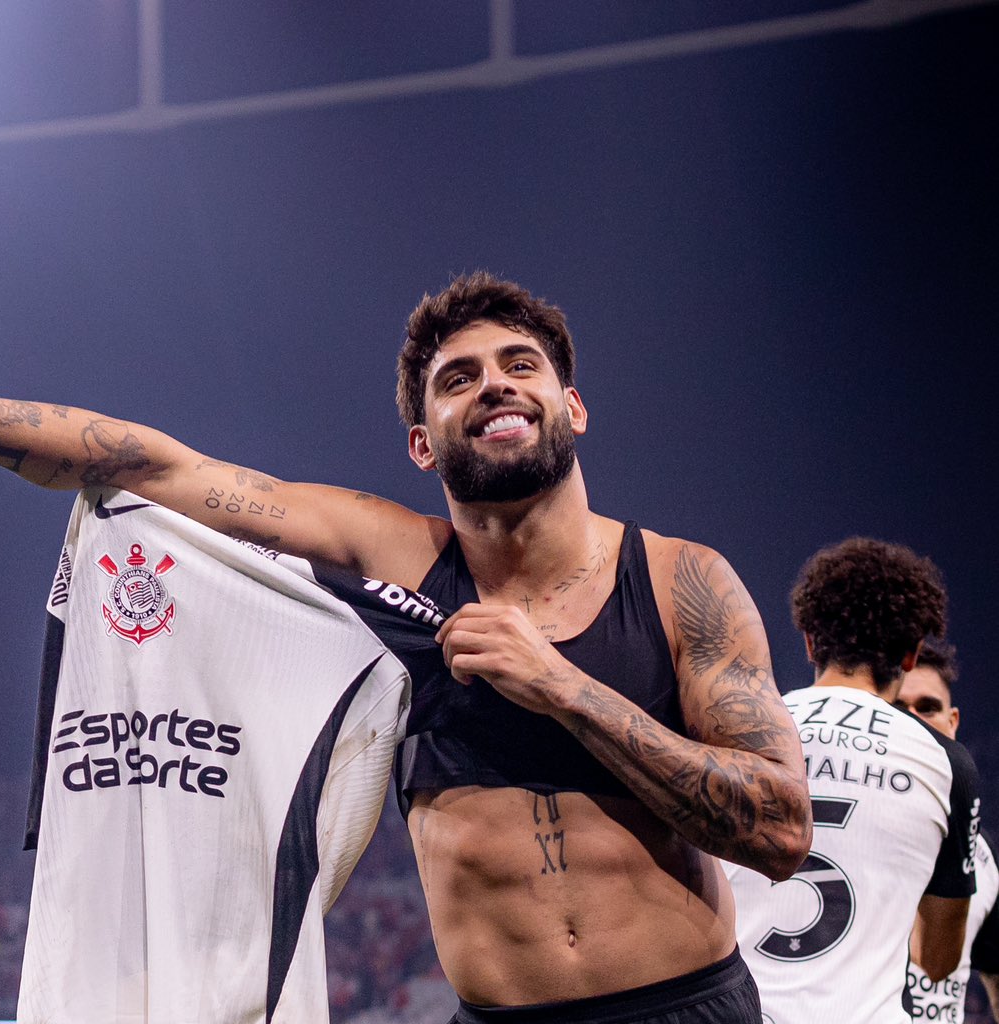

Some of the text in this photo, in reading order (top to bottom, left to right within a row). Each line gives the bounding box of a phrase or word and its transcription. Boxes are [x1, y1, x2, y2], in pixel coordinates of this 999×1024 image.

[52, 707, 242, 756] Esportes
[799, 726, 888, 756] GUROS
[62, 747, 229, 798] da Sorte
[755, 796, 859, 962] 5
